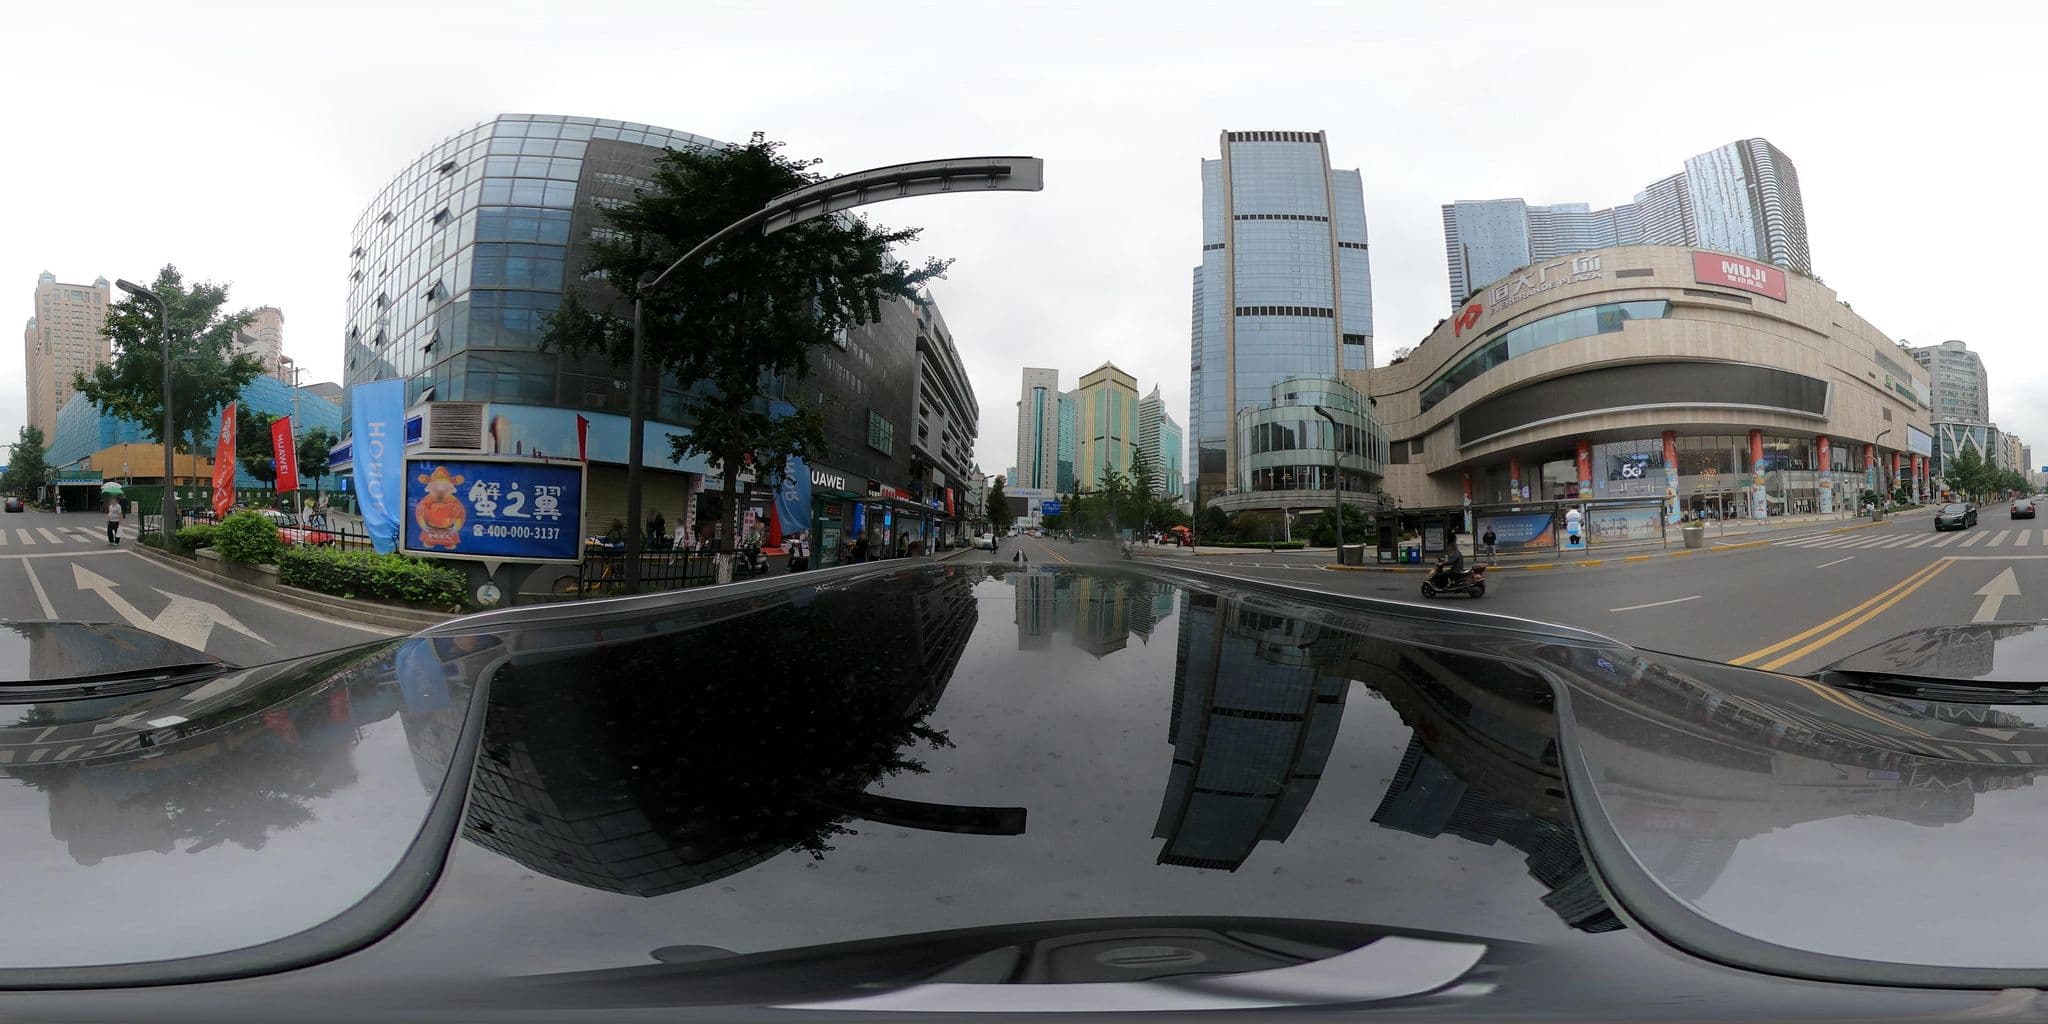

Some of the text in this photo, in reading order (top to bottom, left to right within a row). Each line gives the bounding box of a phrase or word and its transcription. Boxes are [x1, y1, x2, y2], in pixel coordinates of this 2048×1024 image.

[1722, 261, 1767, 282] MUJI
[1490, 271, 1603, 316] EVERGRANDE PLAZA
[278, 433, 288, 475] HUAWEI
[468, 479, 562, 521] 蟹之翼
[811, 470, 845, 490] UAWEI
